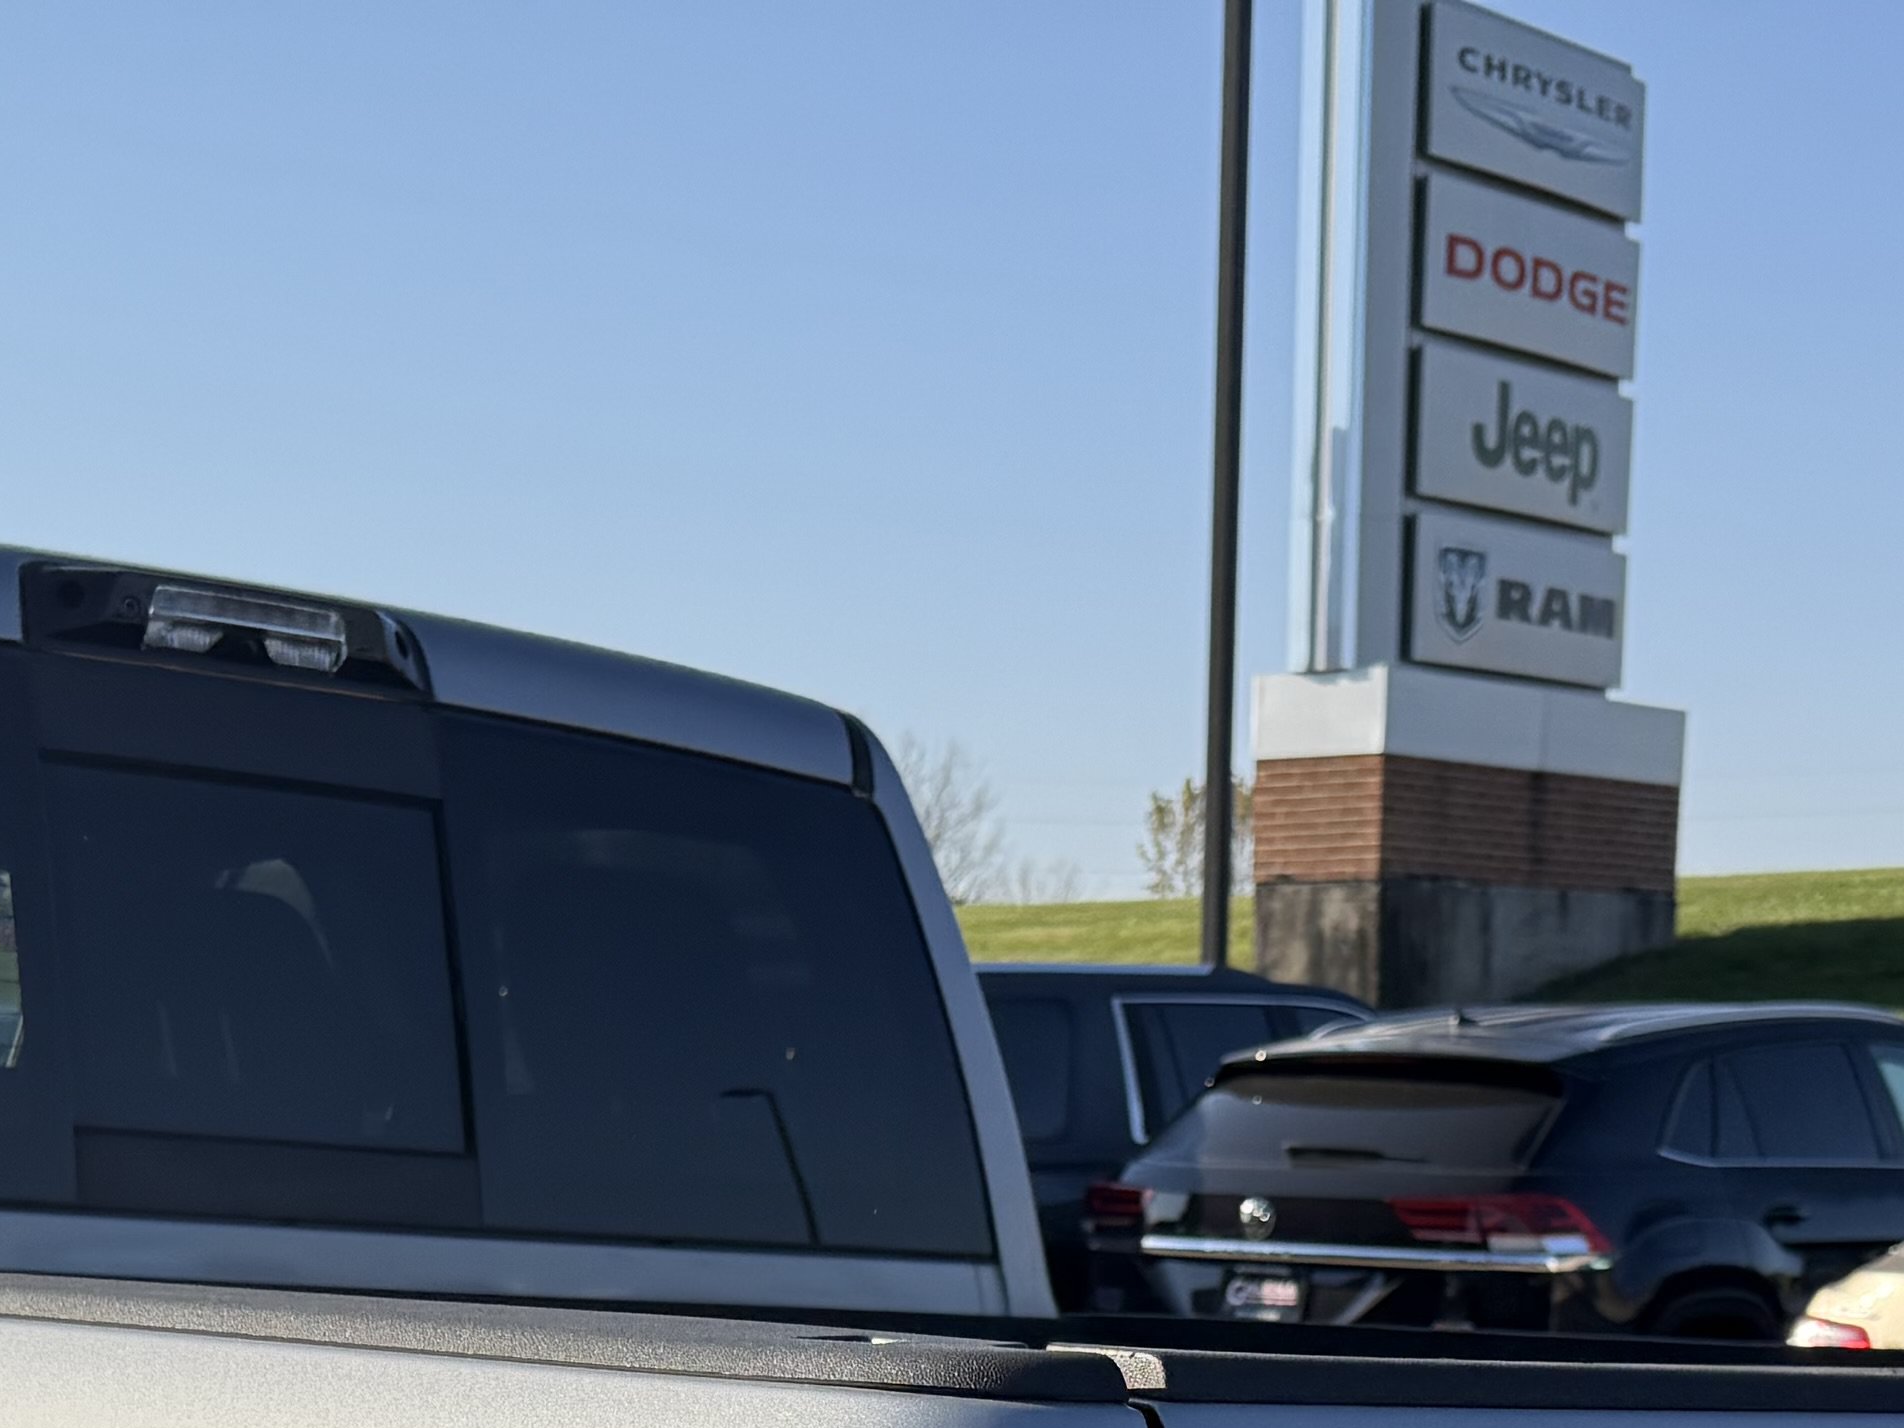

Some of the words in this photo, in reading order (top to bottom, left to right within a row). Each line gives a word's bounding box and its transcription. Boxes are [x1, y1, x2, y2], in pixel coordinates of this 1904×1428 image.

[1457, 46, 1633, 131] CHRYSLER
[1447, 233, 1629, 326] DODGE
[1472, 380, 1599, 507] Jeep
[1498, 578, 1615, 640] RAM
